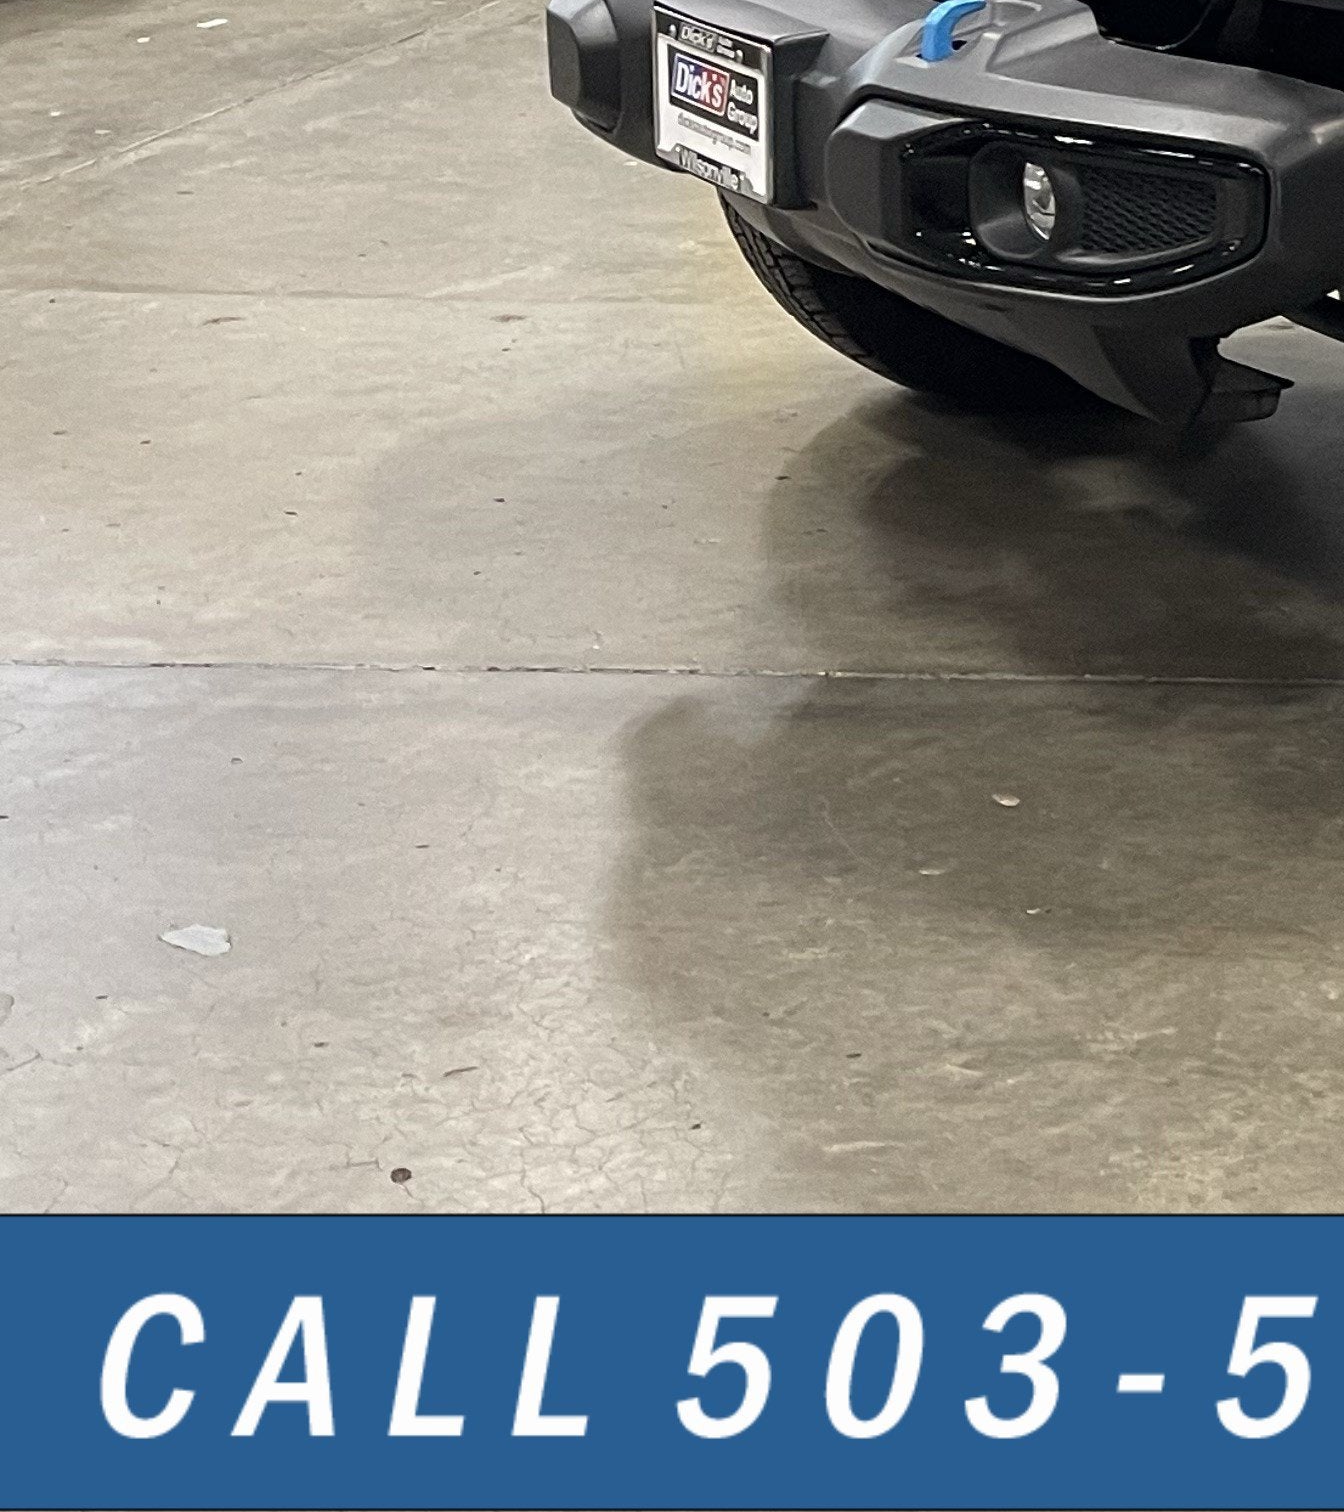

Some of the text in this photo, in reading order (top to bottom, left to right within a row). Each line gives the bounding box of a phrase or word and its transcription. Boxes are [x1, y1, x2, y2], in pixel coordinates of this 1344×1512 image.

[677, 61, 723, 108] Dick's
[729, 79, 753, 105] Auto
[727, 101, 758, 134] Group
